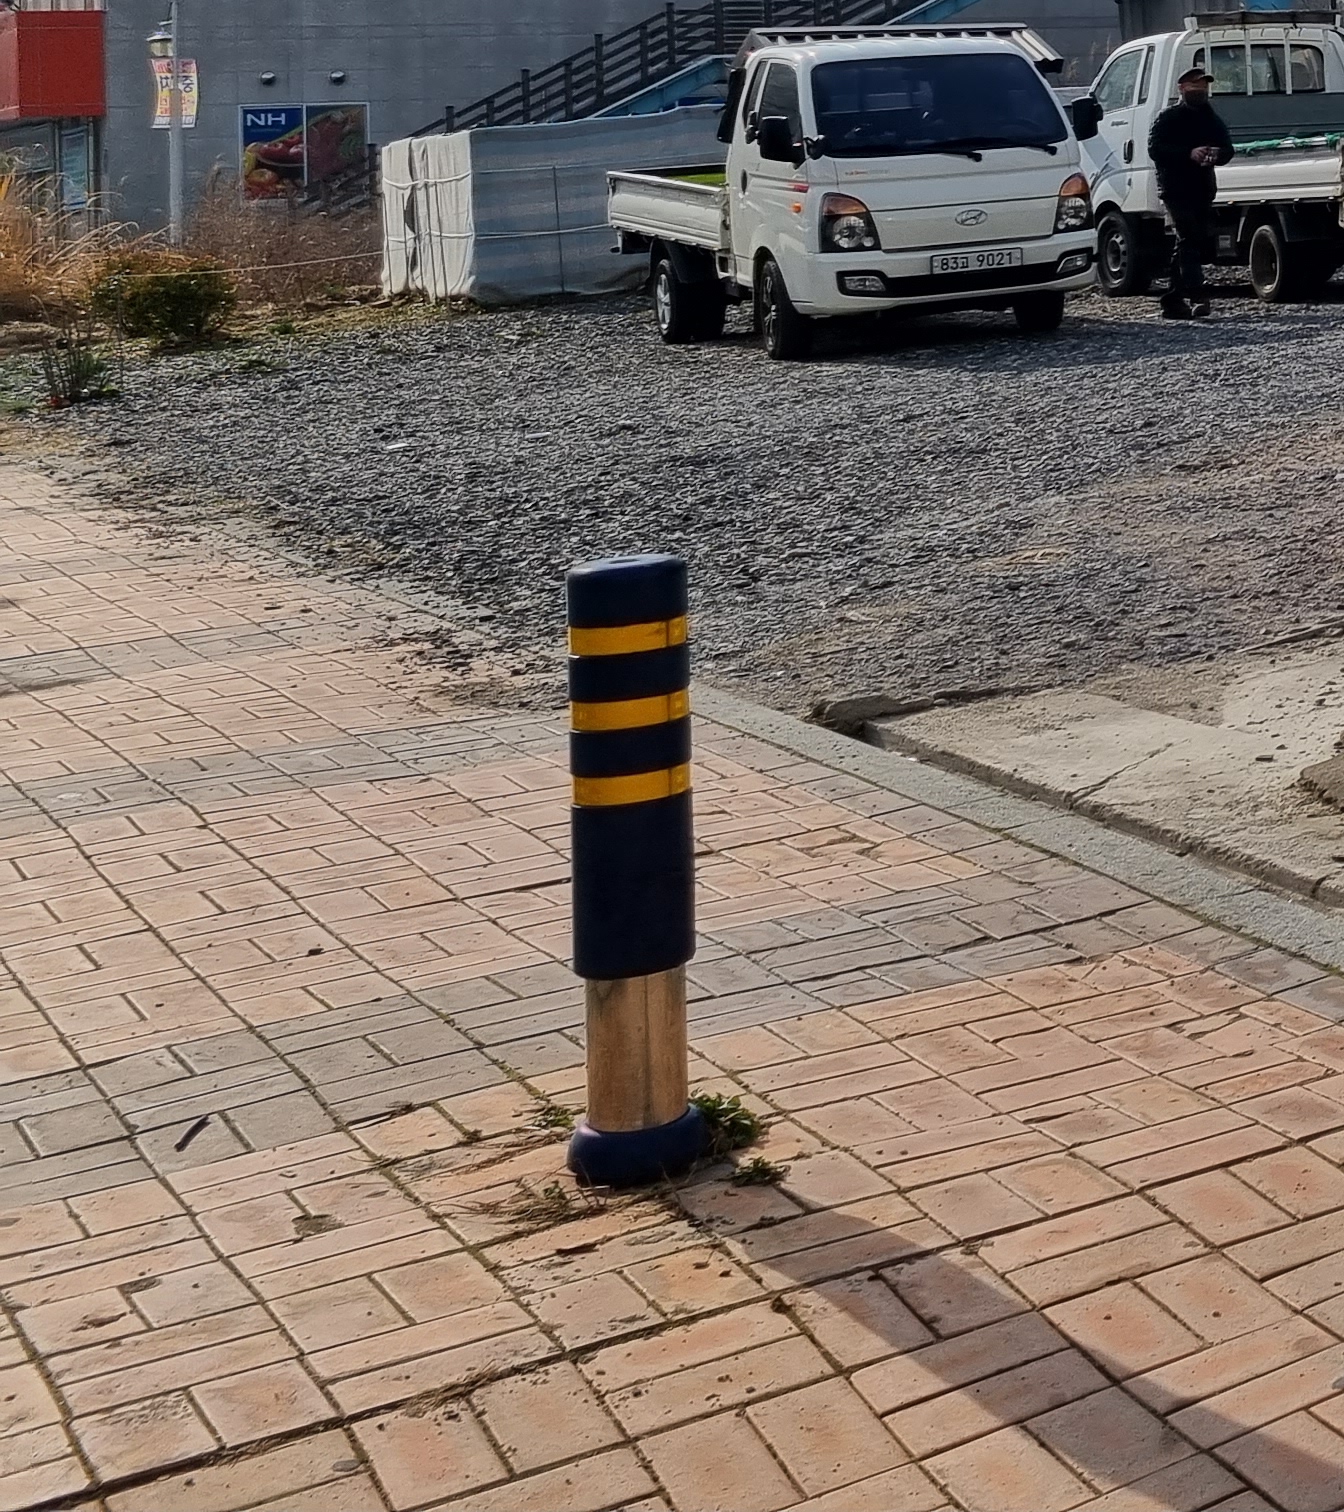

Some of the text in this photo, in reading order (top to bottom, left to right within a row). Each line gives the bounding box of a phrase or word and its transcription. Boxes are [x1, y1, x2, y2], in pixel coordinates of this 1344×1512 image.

[246, 112, 286, 126] NH
[940, 251, 1013, 271] 83고 9021
